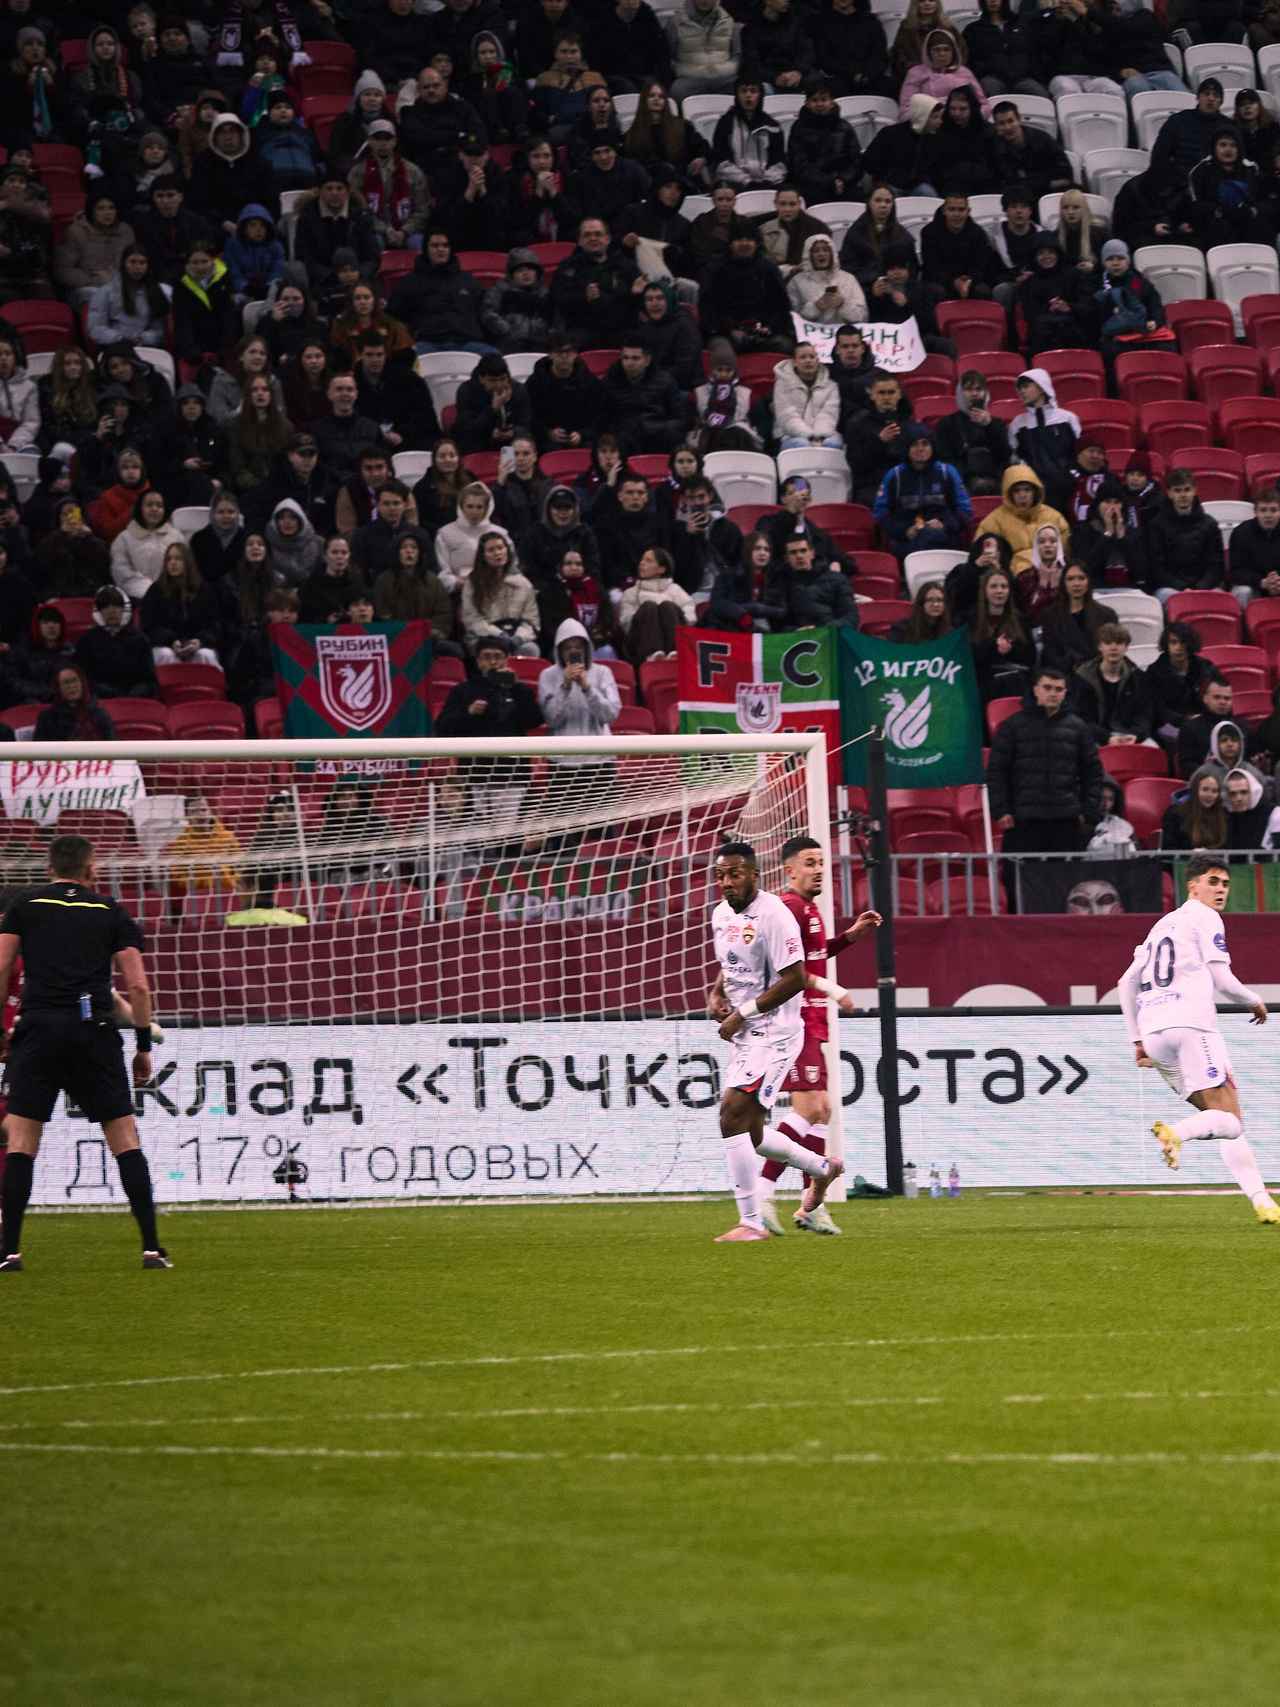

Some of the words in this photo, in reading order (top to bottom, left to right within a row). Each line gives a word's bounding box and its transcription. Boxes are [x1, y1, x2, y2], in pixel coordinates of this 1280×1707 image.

[803, 323, 899, 344] РУИН
[319, 639, 385, 652] РУБИН
[697, 640, 731, 687] F
[781, 640, 823, 688] C
[854, 660, 878, 687] 12
[881, 656, 963, 685] ИГРОК
[66, 1057, 363, 1125] клад
[396, 1037, 721, 1112] «Точка
[775, 1047, 1090, 1110] оста»
[66, 1140, 114, 1198] Д
[341, 1143, 599, 1189] годовых
